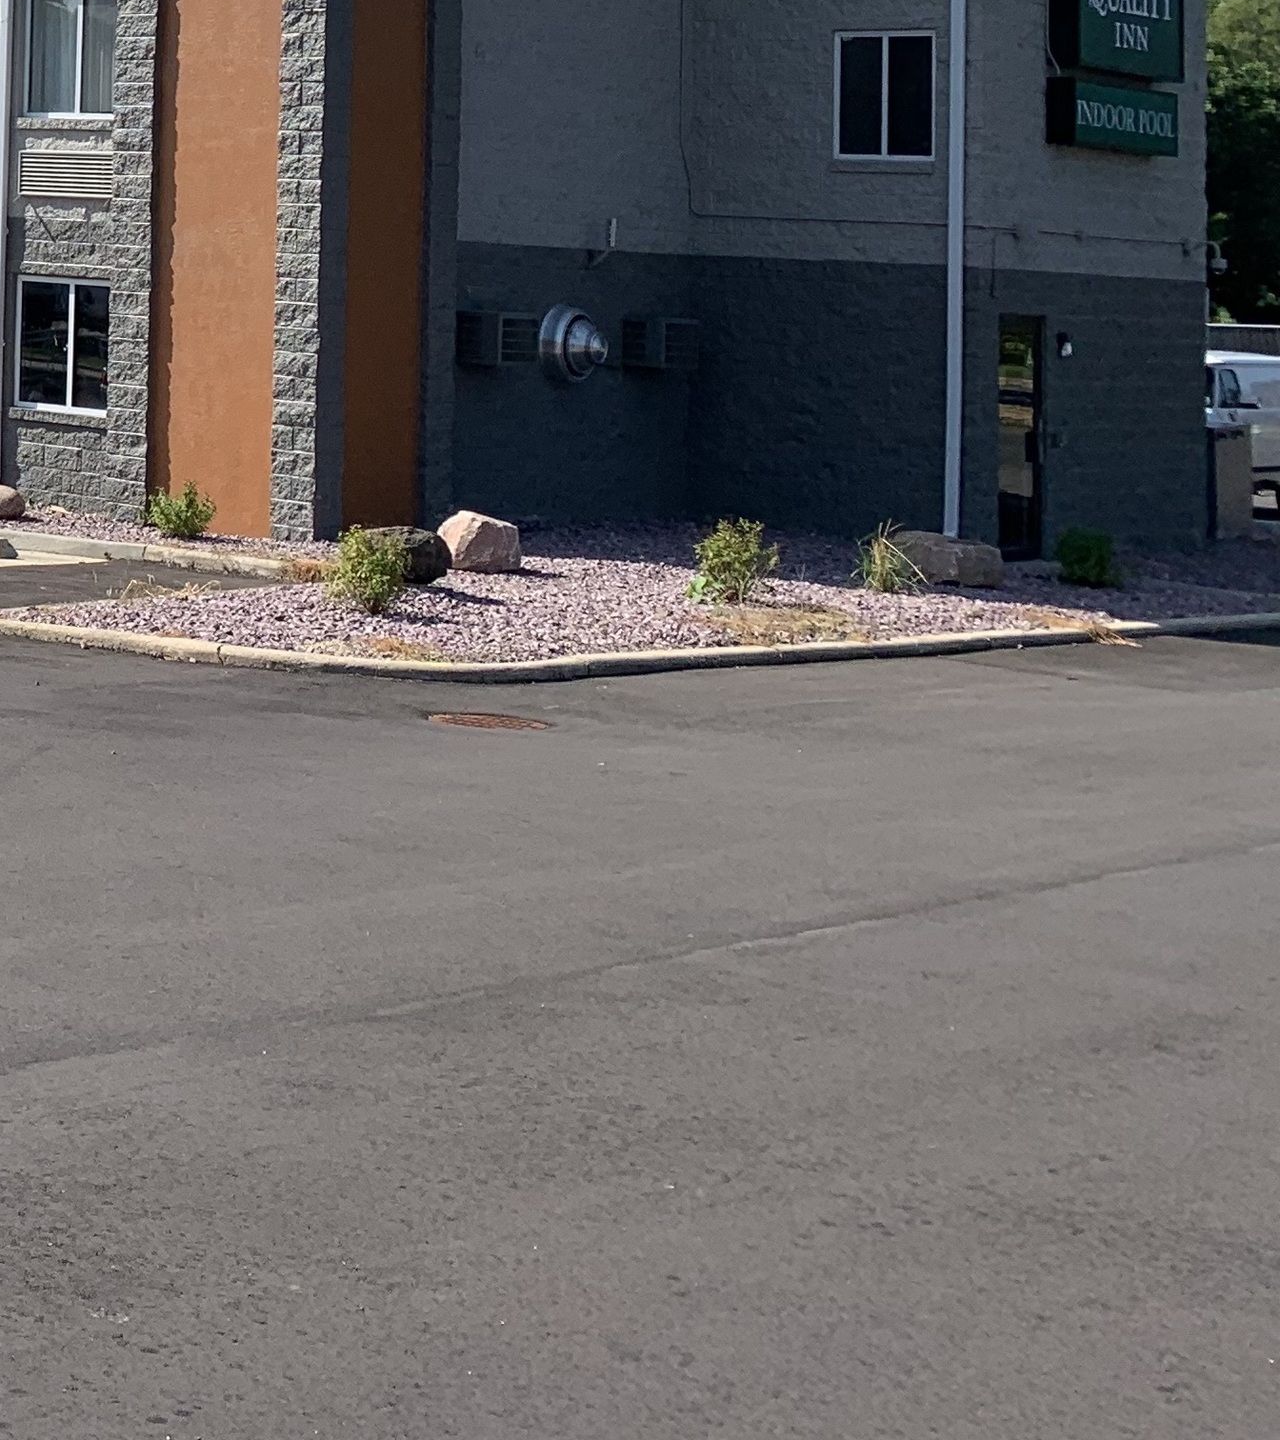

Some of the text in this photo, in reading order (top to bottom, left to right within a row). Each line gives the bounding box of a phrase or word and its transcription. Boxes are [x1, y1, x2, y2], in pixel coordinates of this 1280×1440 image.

[1114, 22, 1149, 51] INN
[1076, 99, 1175, 138] INDOOR POOL
